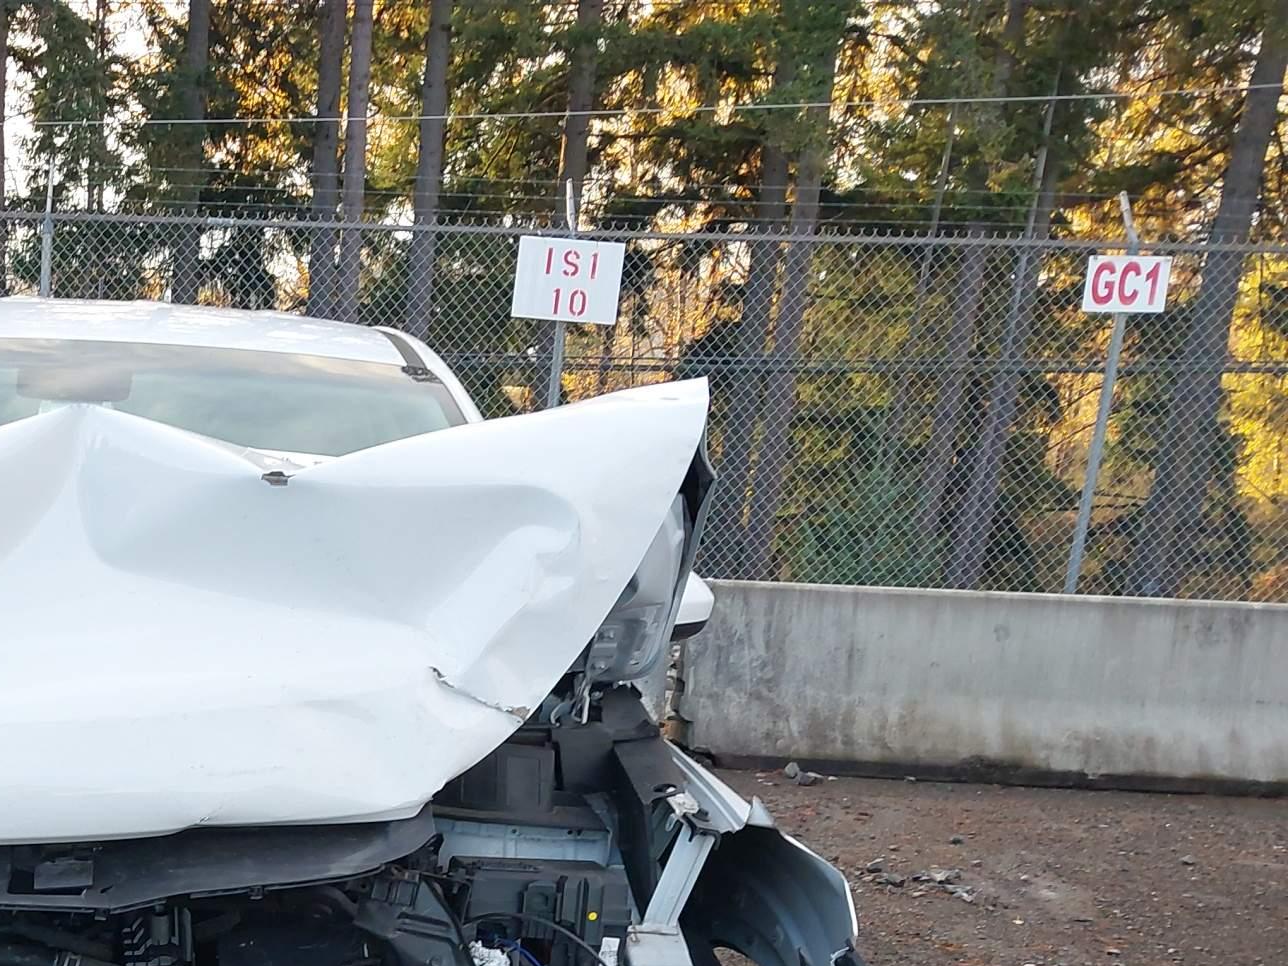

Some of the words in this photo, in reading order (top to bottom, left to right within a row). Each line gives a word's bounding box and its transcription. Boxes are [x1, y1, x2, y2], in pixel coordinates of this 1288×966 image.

[545, 247, 599, 280] IS1
[1091, 261, 1161, 306] GC1
[552, 288, 587, 317] 10
